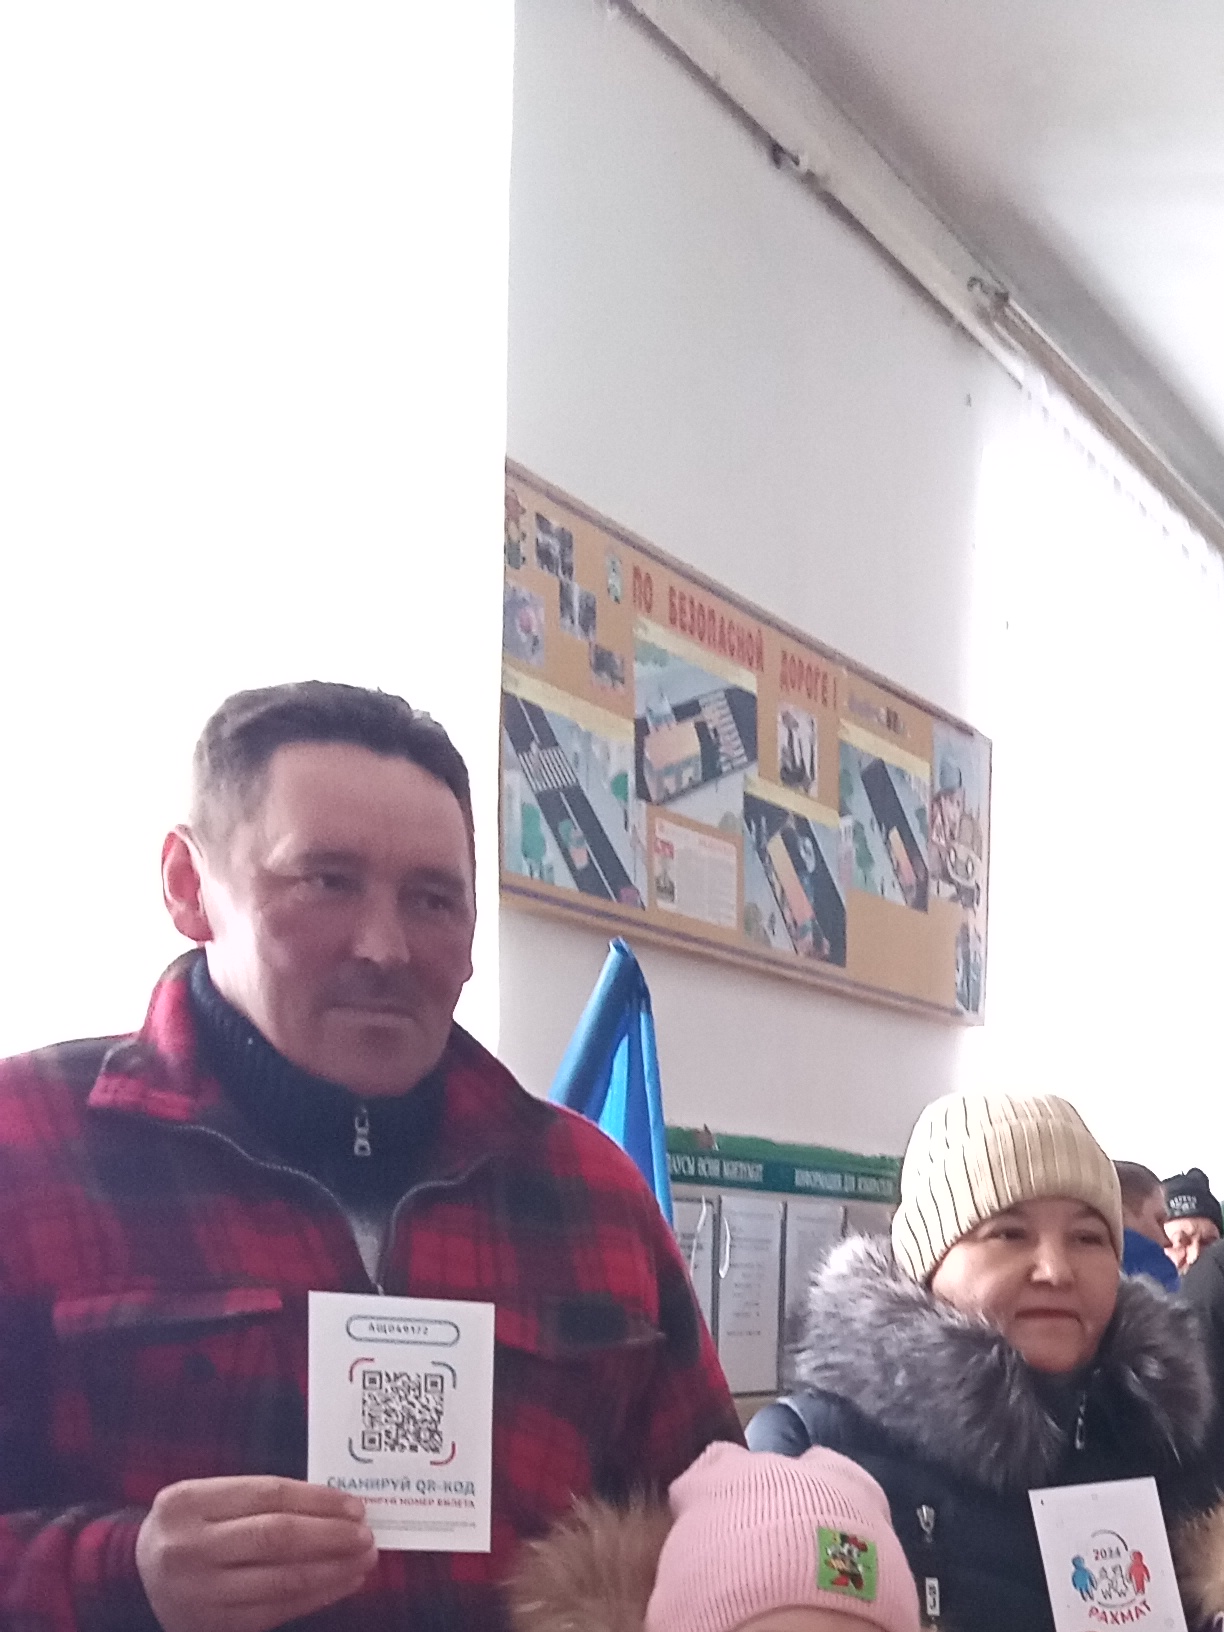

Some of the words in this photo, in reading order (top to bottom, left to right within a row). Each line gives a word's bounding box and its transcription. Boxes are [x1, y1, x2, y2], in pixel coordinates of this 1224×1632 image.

[632, 566, 654, 614] ПО
[668, 584, 765, 673] БЕЗОПАСНОЙ
[327, 1475, 411, 1493] СКАНИРУЙ
[415, 1479, 476, 1497] QR-КОД
[1092, 1547, 1123, 1561] 2024
[1088, 1600, 1152, 1625] РАХМАТ
